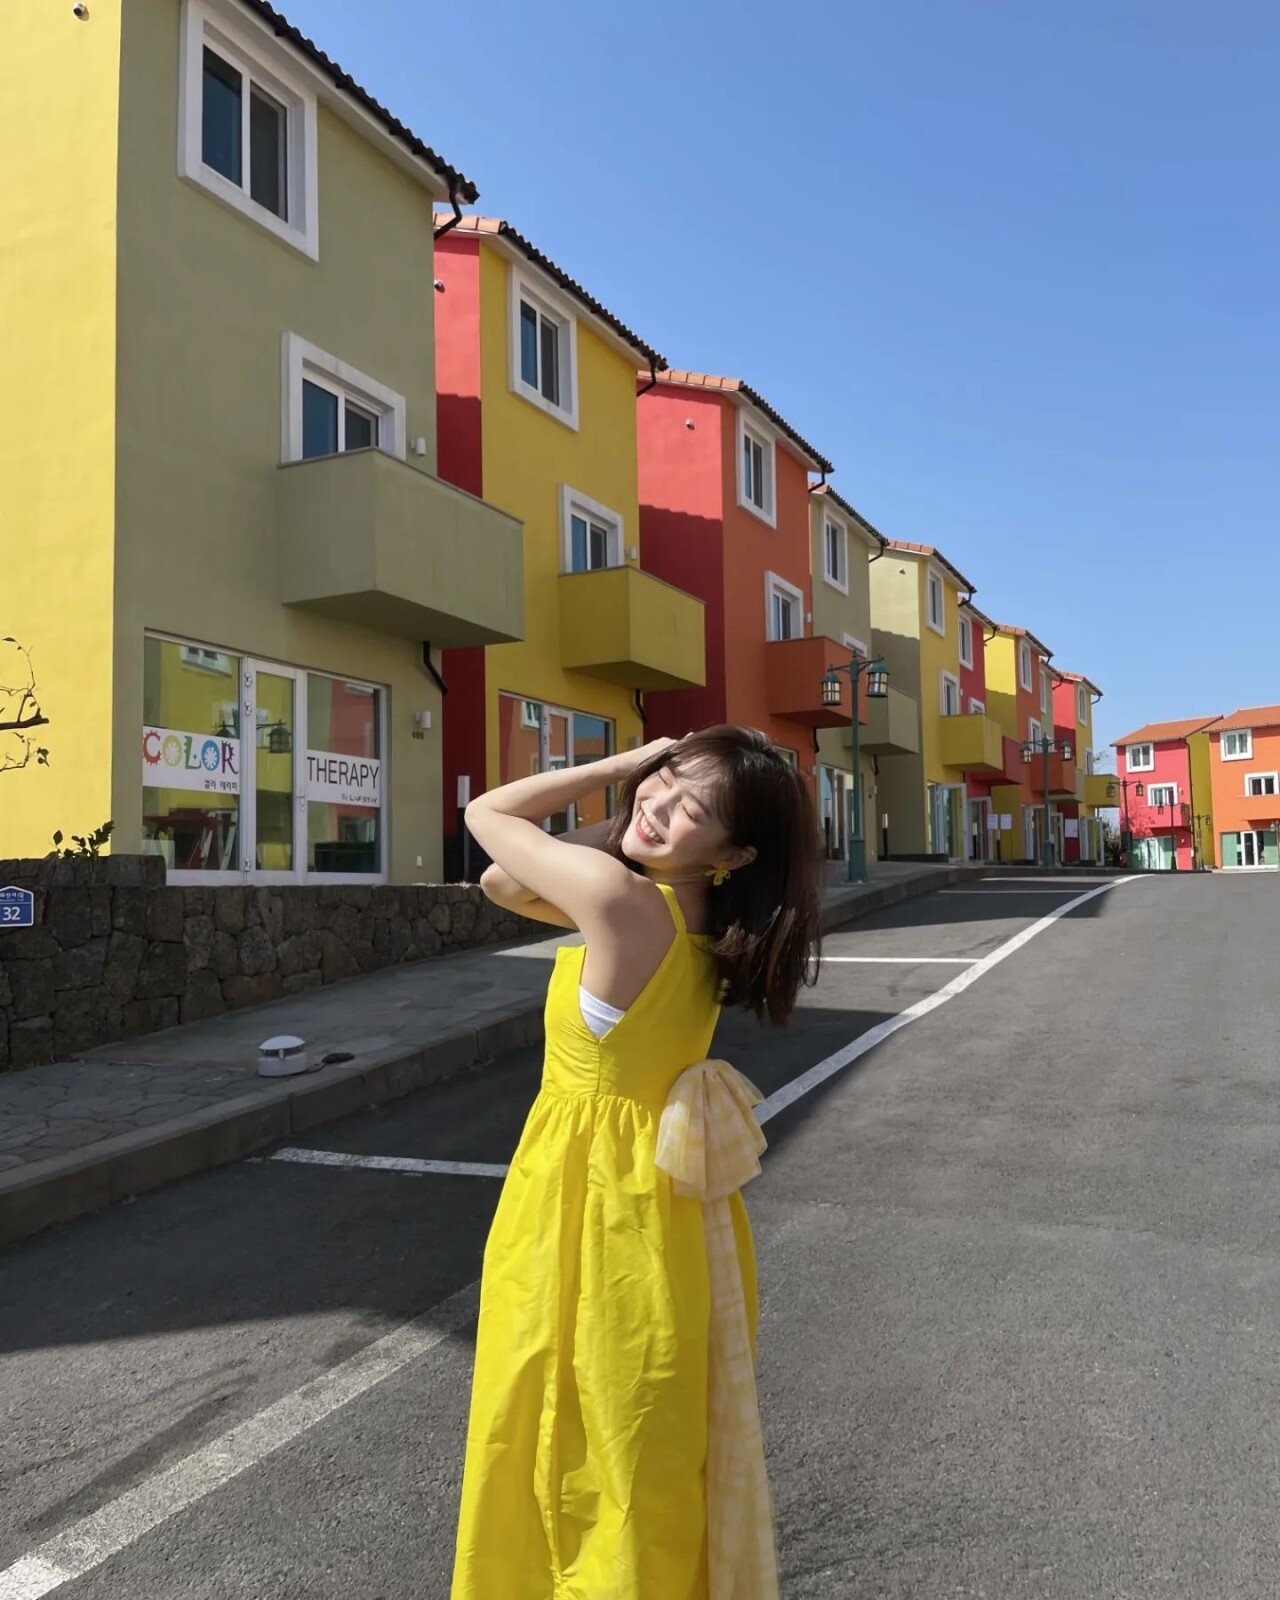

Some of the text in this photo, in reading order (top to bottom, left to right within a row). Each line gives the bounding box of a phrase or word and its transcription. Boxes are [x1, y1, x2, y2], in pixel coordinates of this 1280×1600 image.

[143, 729, 239, 775] COLOR
[307, 756, 379, 789] THERAPY
[3, 906, 20, 921] 32
